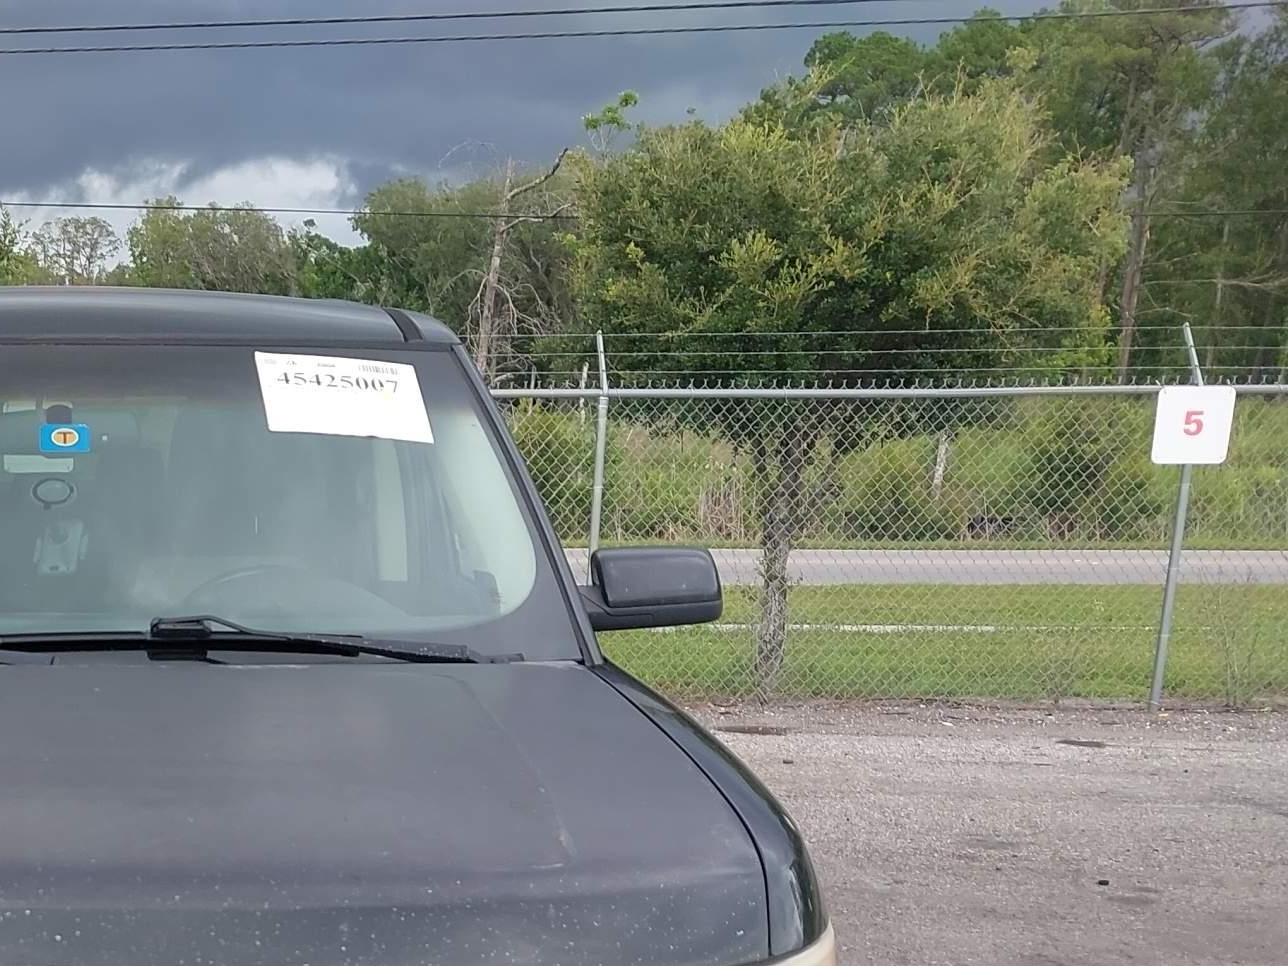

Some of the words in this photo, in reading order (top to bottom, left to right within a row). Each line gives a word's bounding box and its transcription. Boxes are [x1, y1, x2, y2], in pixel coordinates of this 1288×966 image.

[276, 371, 399, 393] 45425007
[1183, 410, 1205, 437] 5
[56, 431, 75, 445] T
